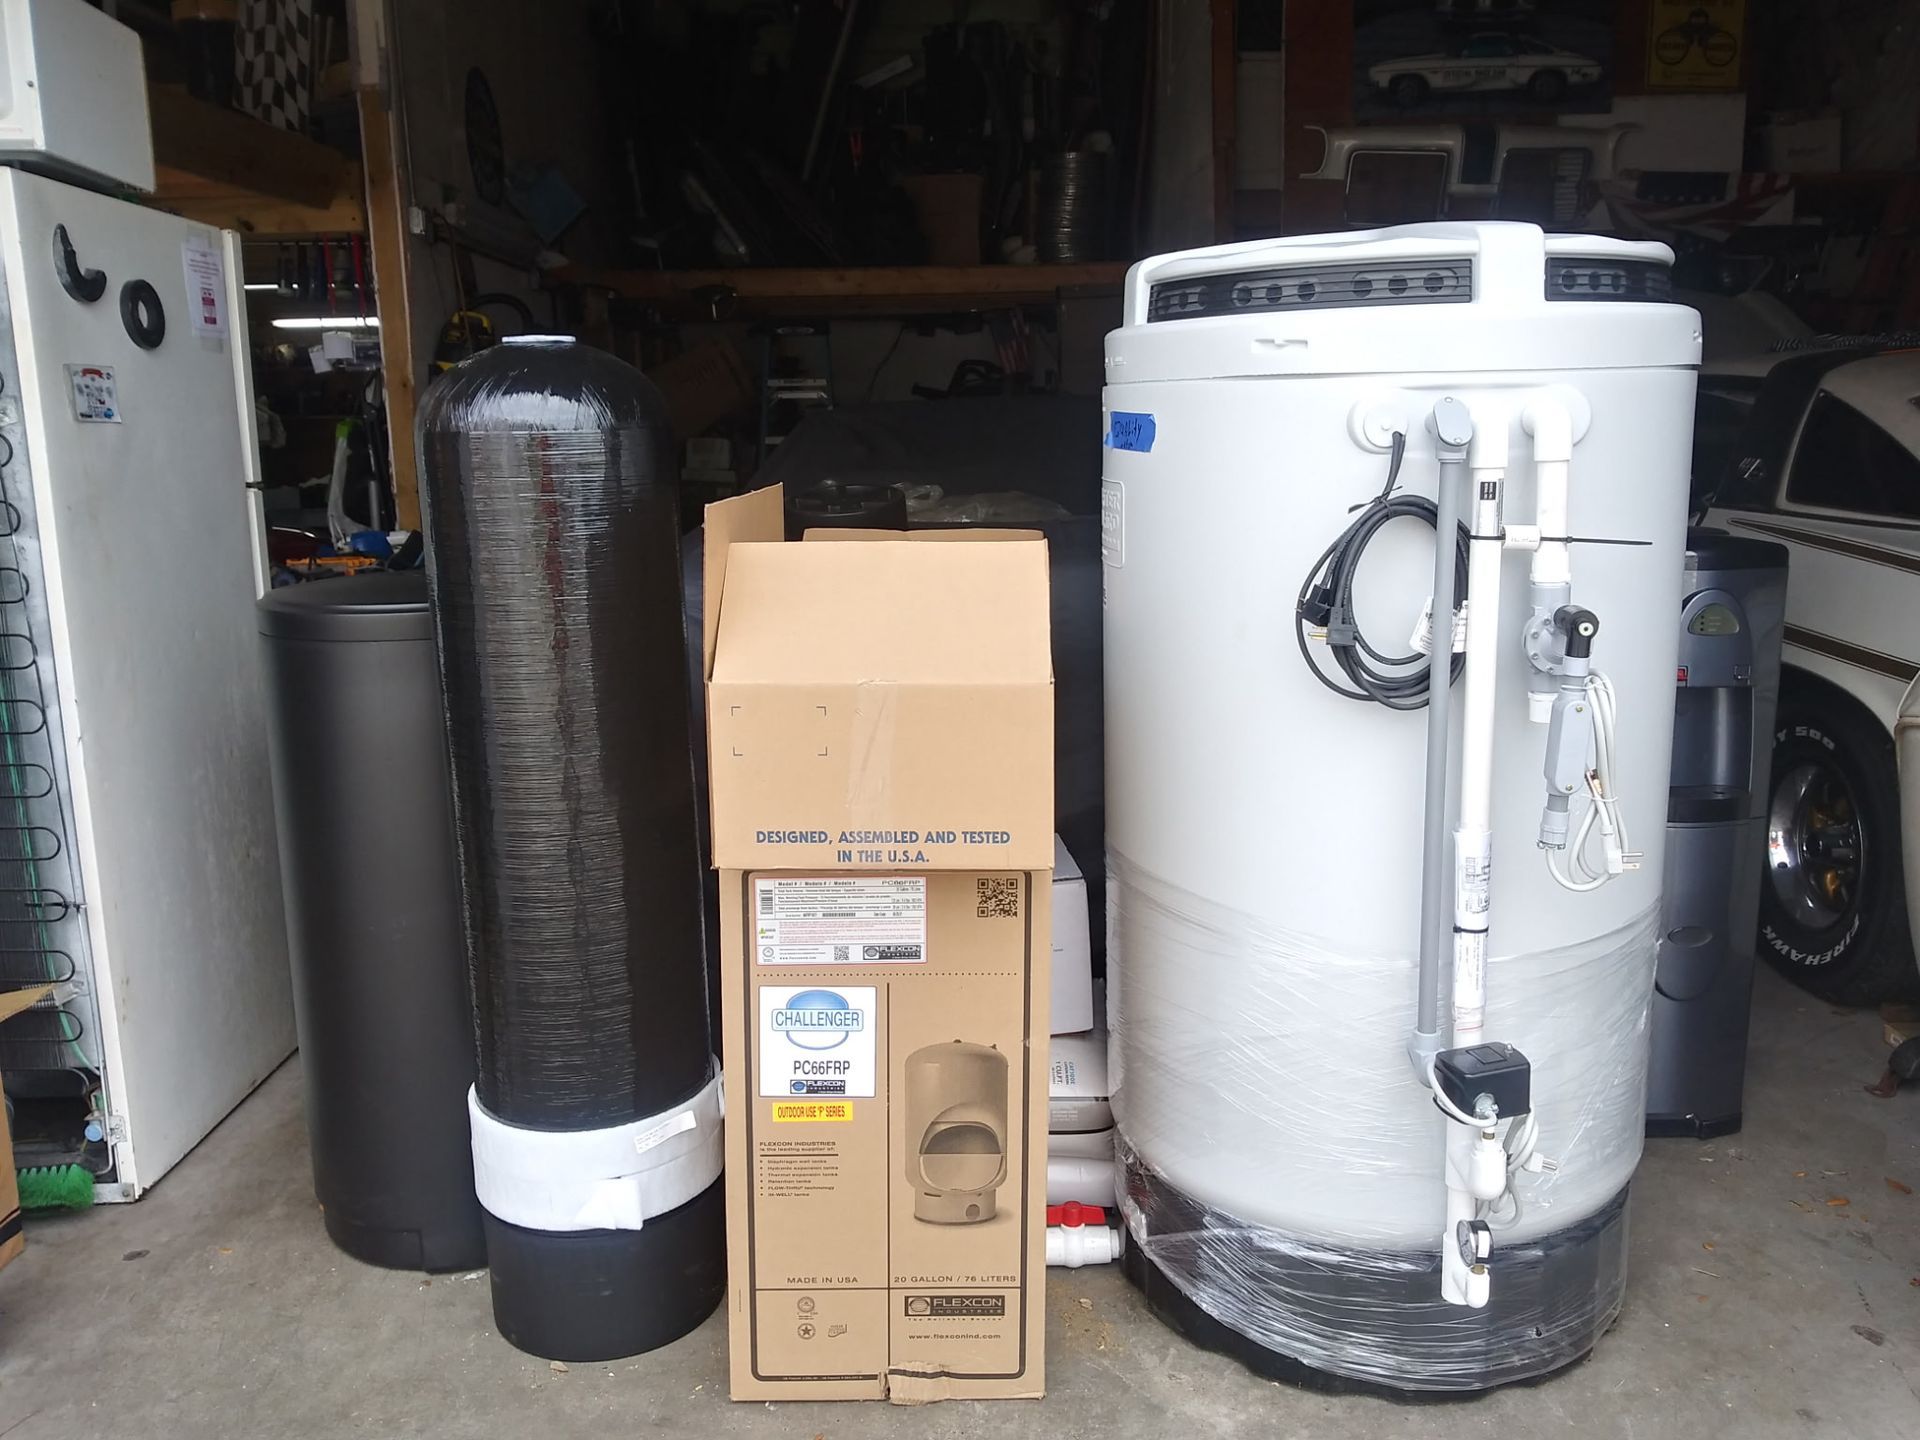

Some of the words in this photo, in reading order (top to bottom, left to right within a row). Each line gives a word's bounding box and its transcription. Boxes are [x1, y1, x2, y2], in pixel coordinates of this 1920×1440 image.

[1795, 726, 1835, 750] 500
[756, 830, 833, 845] DESIGNED,
[838, 830, 920, 844] ASSEMBLED
[924, 830, 957, 844] AND
[961, 830, 1011, 844] TESTED
[837, 850, 852, 863] IN
[857, 850, 883, 863] THE
[888, 850, 930, 863] U.S.A.
[1762, 911, 1860, 966] FIREHAWK
[775, 1011, 860, 1027] CHALLENGER
[793, 1060, 851, 1075] PC66FRP
[777, 1106, 805, 1118] OUTDOOR
[806, 1106, 817, 1118] USE
[826, 1105, 846, 1118] SERIES
[787, 1276, 818, 1284] MADE
[821, 1276, 833, 1284] IN
[837, 1276, 859, 1284] USA
[911, 1275, 953, 1283] GALLON
[933, 1298, 1002, 1307] FLEXCON
